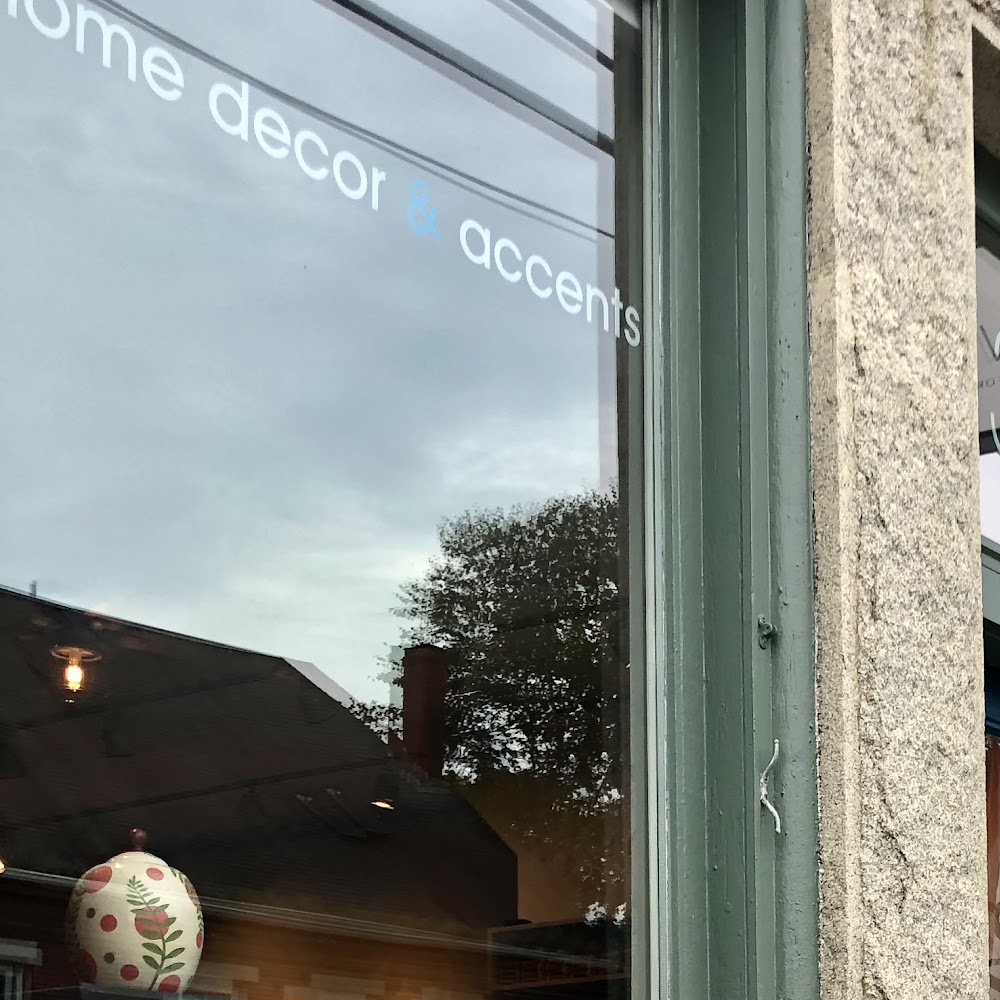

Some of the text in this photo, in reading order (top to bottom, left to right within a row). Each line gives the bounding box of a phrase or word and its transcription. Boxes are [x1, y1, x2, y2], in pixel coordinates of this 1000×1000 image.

[7, 0, 641, 348] ome decor & accents
